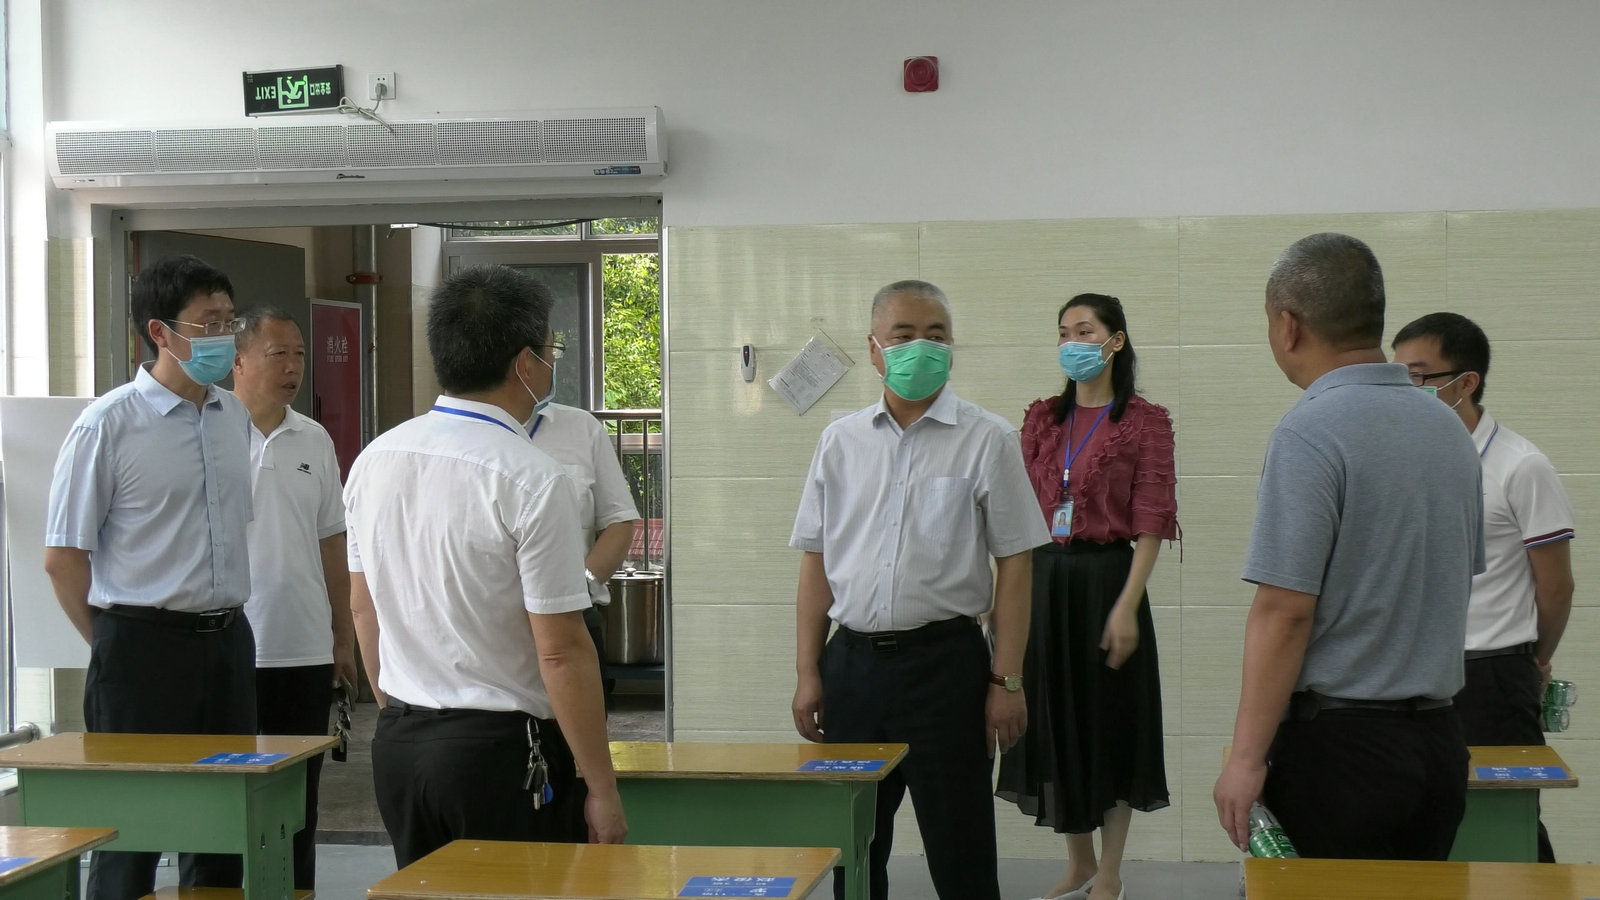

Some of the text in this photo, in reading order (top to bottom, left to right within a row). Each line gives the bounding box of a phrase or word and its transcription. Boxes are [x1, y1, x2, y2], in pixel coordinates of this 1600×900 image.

[255, 85, 276, 100] EXIT
[310, 82, 331, 96] 安全出口
[327, 335, 348, 354] 消火栓
